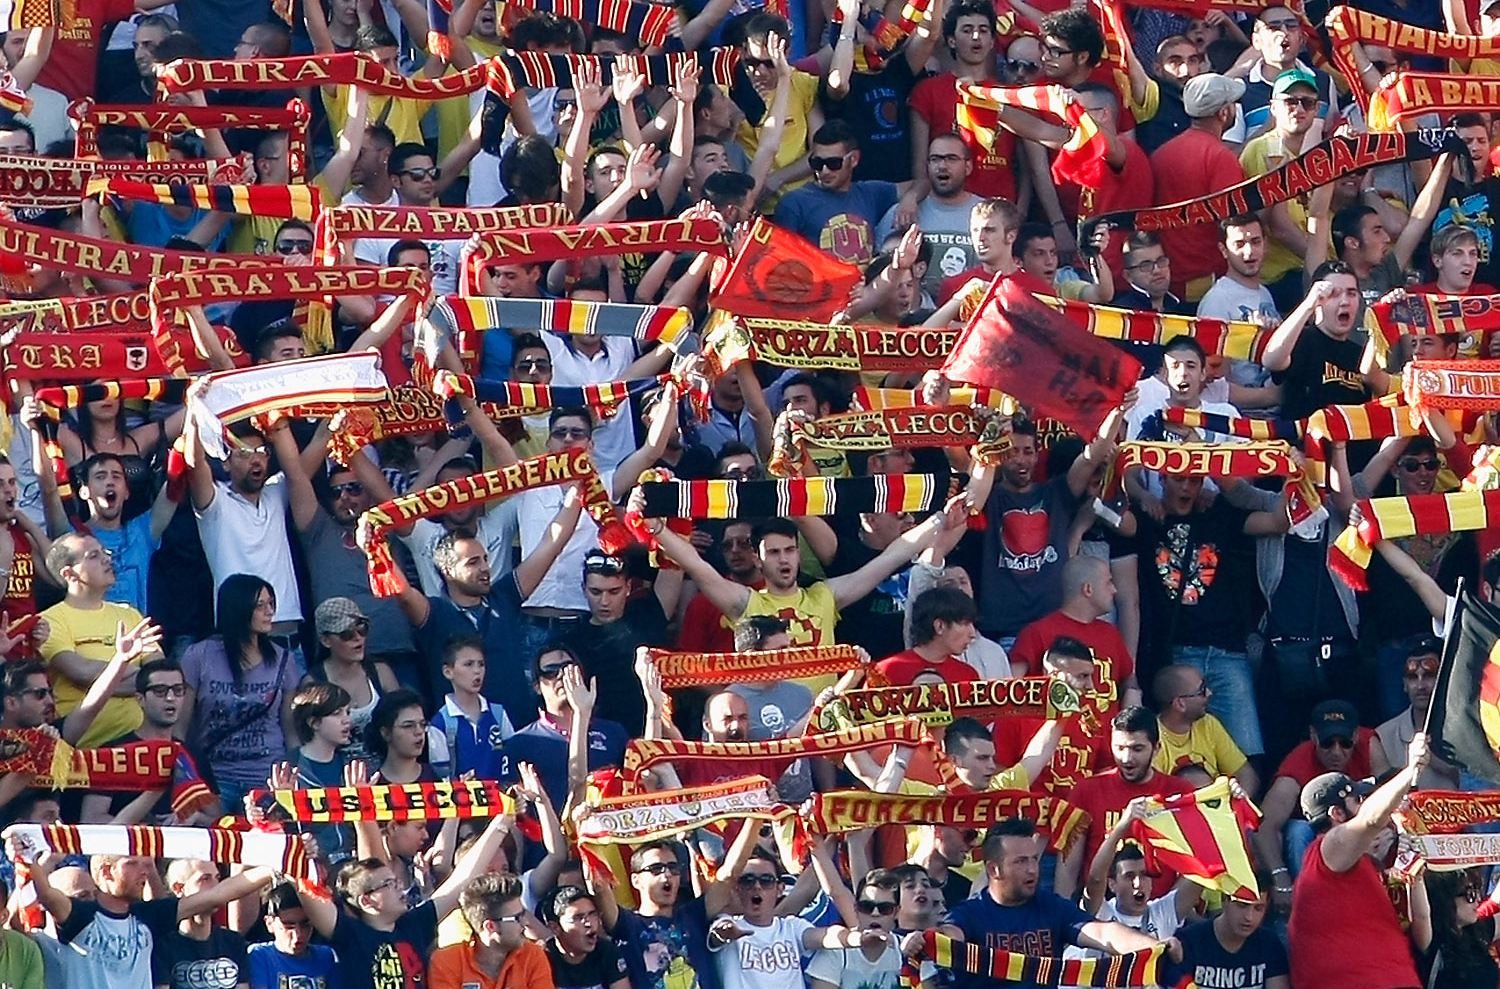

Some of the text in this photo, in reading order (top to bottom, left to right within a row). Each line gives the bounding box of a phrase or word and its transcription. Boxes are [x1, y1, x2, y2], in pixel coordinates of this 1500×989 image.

[354, 58, 483, 98] LECCE
[1401, 80, 1428, 110] LA
[1259, 131, 1408, 208] RAGAZZI
[754, 327, 855, 359] FORZA
[852, 680, 1044, 717] FORZA LECCE
[740, 937, 800, 973] LECCE
[1194, 962, 1268, 989] BRING IT
